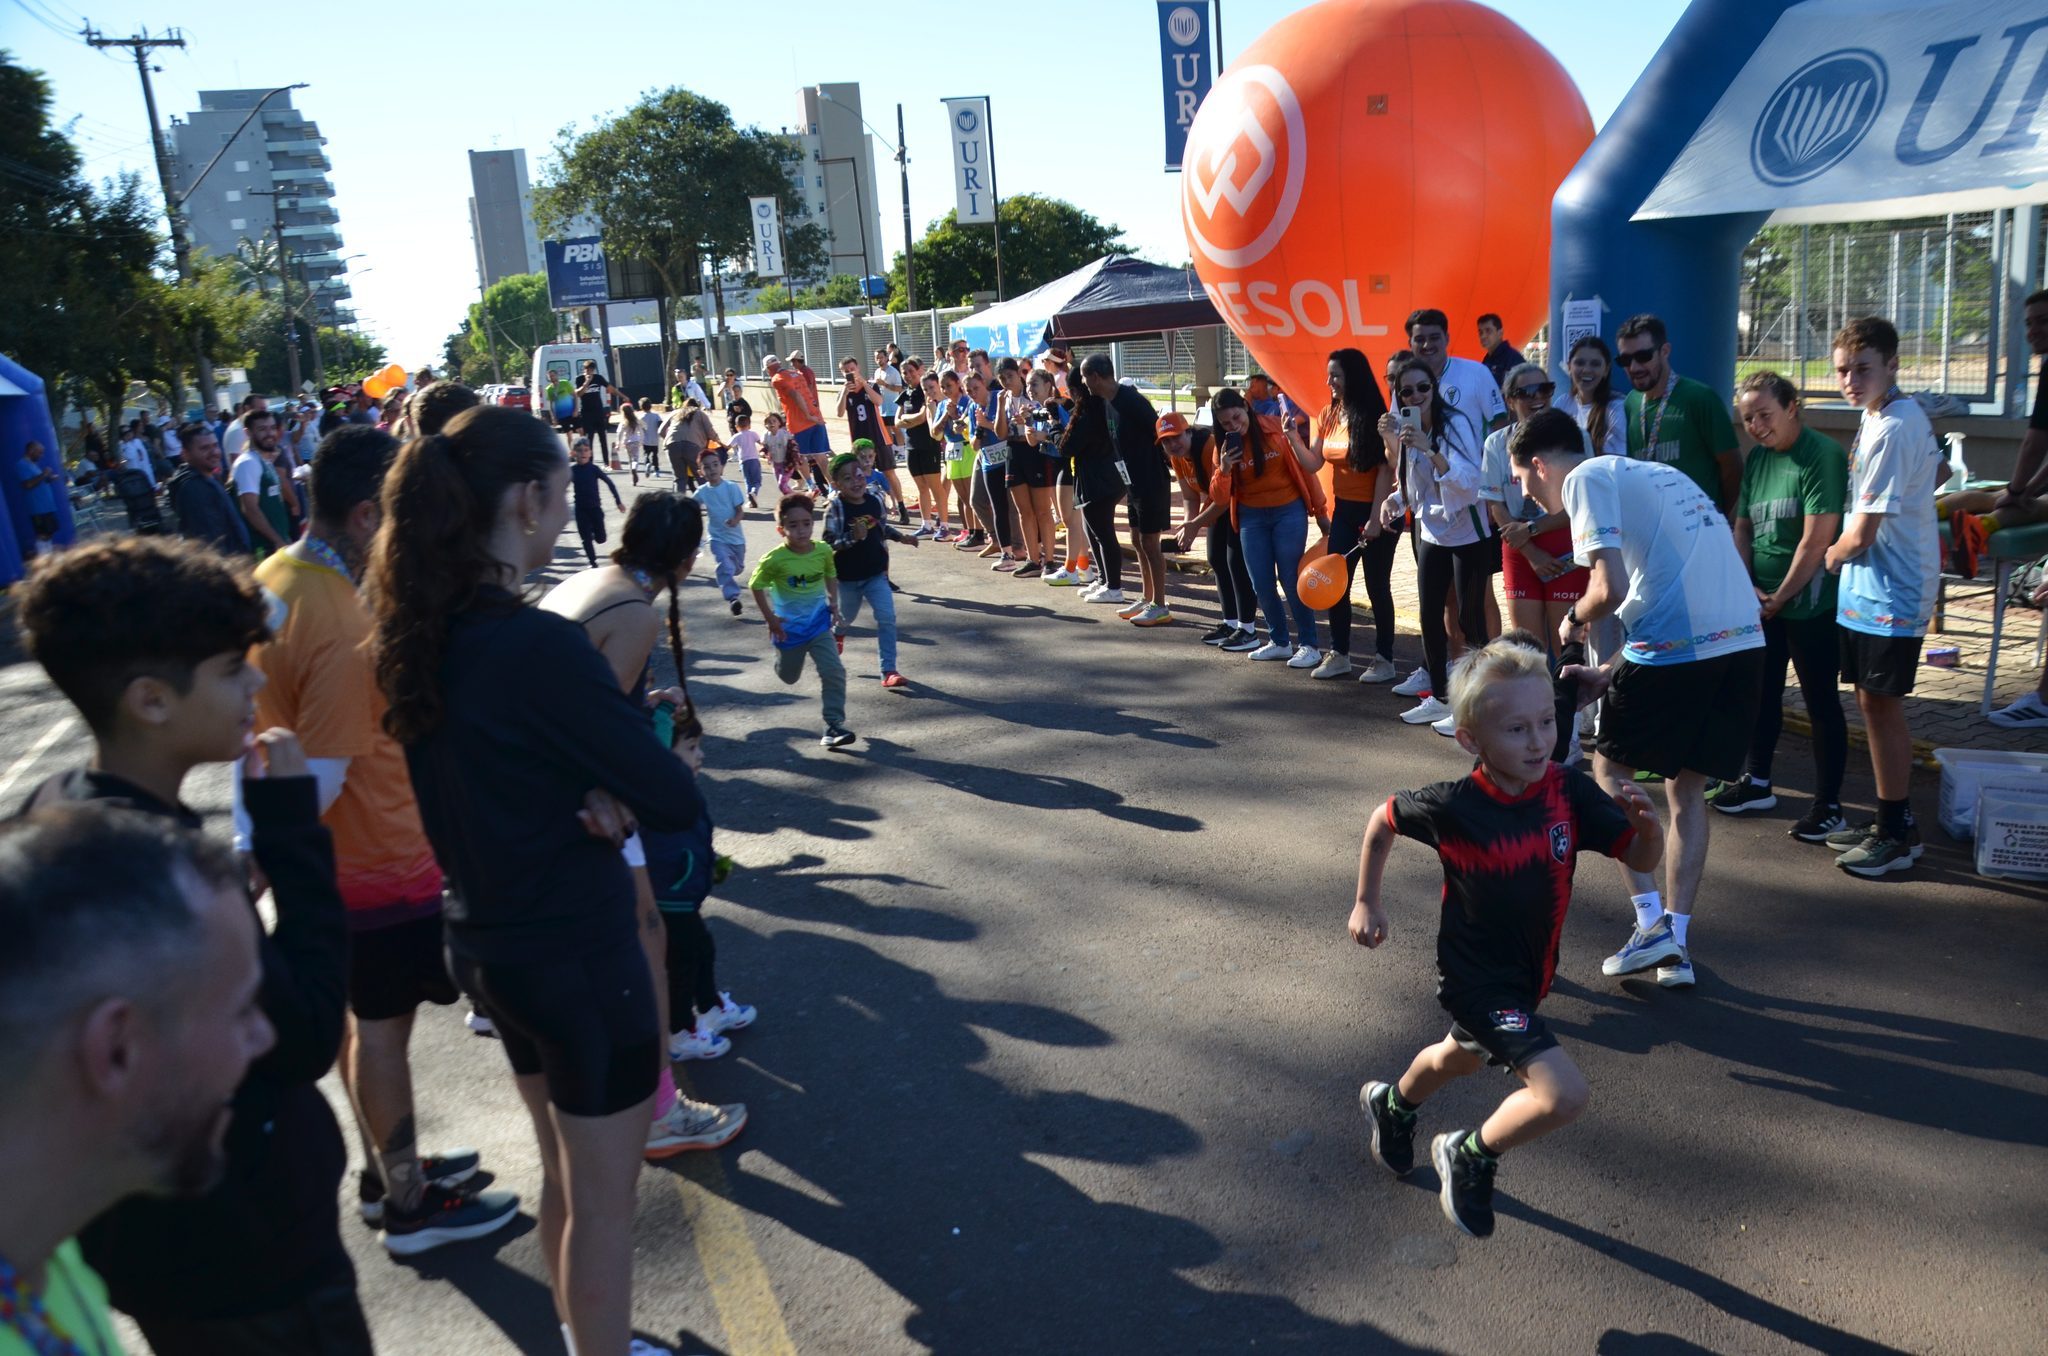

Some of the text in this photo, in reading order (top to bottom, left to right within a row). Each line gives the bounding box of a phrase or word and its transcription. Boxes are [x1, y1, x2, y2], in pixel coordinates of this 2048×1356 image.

[959, 141, 982, 215] URI
[759, 223, 775, 271] URI
[857, 404, 867, 422] 9
[1553, 592, 1580, 600] MORE
